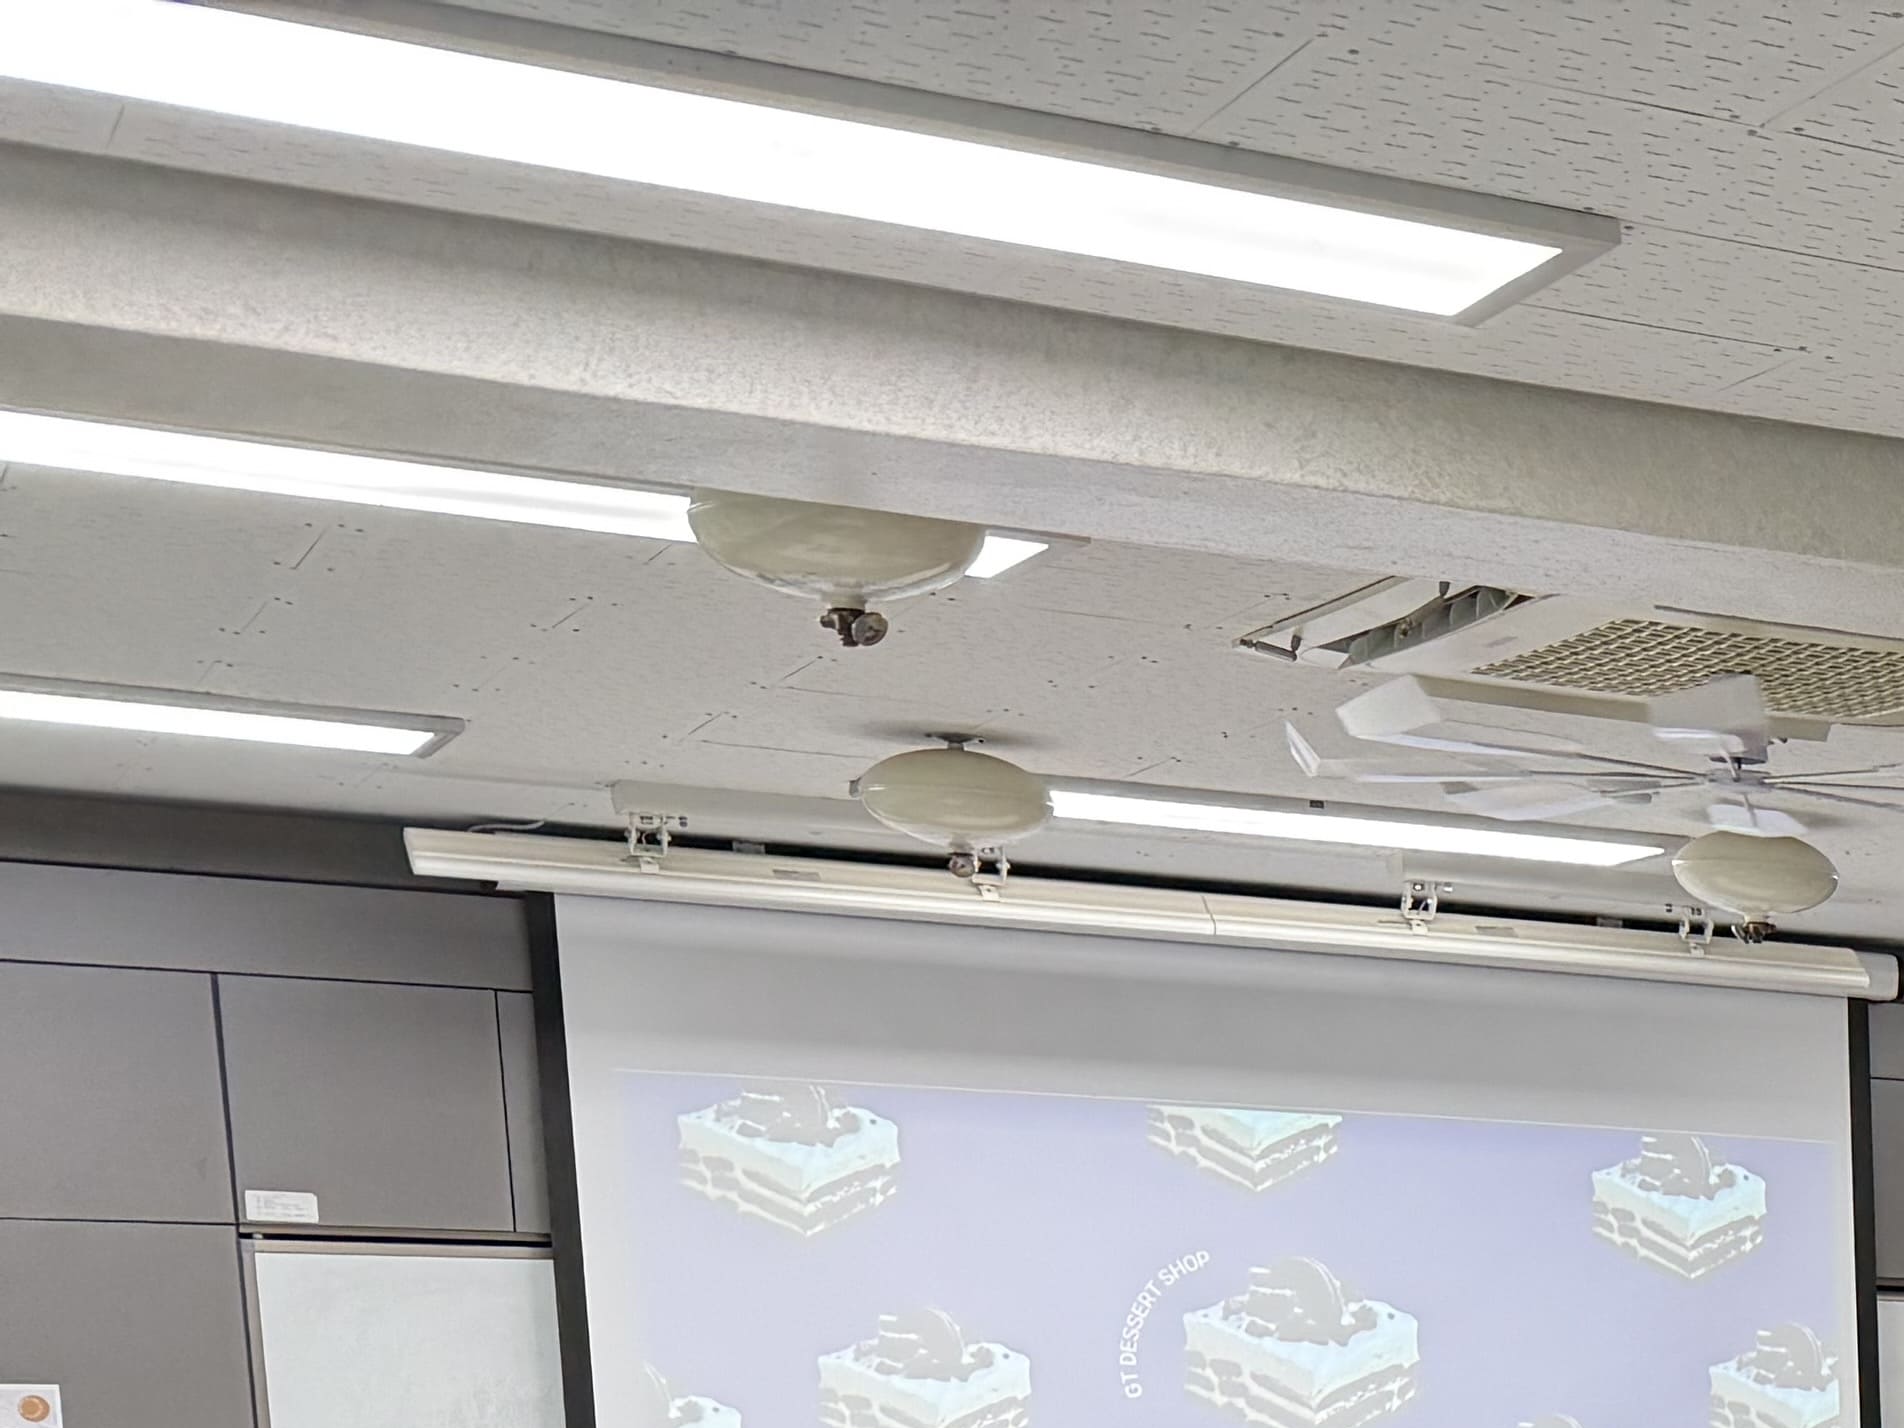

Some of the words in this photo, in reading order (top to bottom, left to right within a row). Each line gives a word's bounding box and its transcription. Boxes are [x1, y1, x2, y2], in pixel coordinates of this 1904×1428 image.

[1158, 1250, 1210, 1285] SHOP
[1120, 1280, 1162, 1365] DESSERT
[1120, 1371, 1142, 1398] GT
